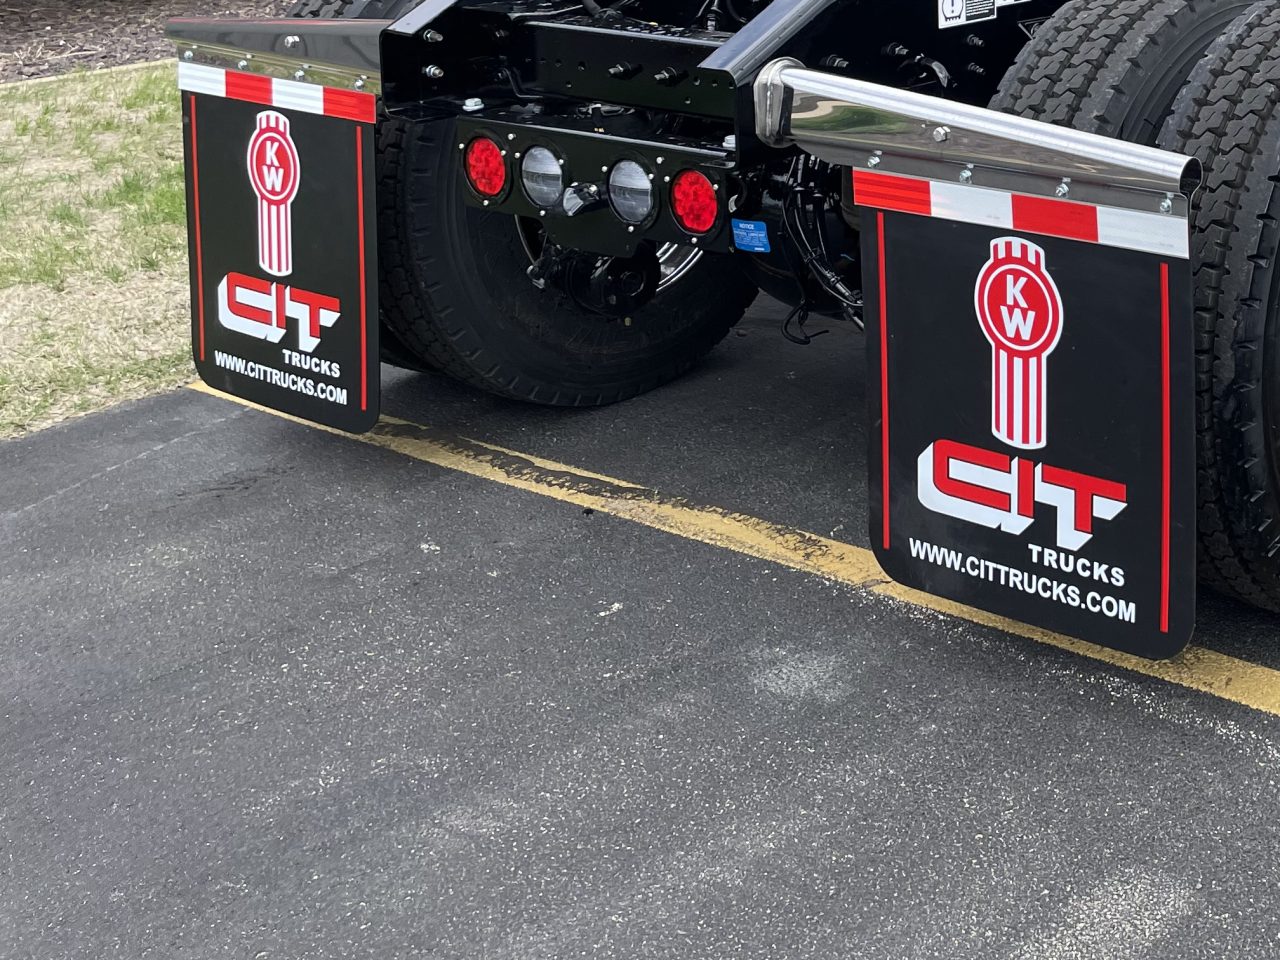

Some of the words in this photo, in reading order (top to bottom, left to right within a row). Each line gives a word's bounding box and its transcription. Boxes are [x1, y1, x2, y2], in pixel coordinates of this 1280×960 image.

[217, 271, 341, 353] CIT
[214, 349, 348, 406] WWW.CITTRUCKS.COM
[282, 348, 341, 378] TRUCKS
[917, 438, 1128, 551] CIT
[909, 537, 1136, 624] WWW.CITTRUCKS.COM
[1028, 543, 1125, 587] TRUCKS
